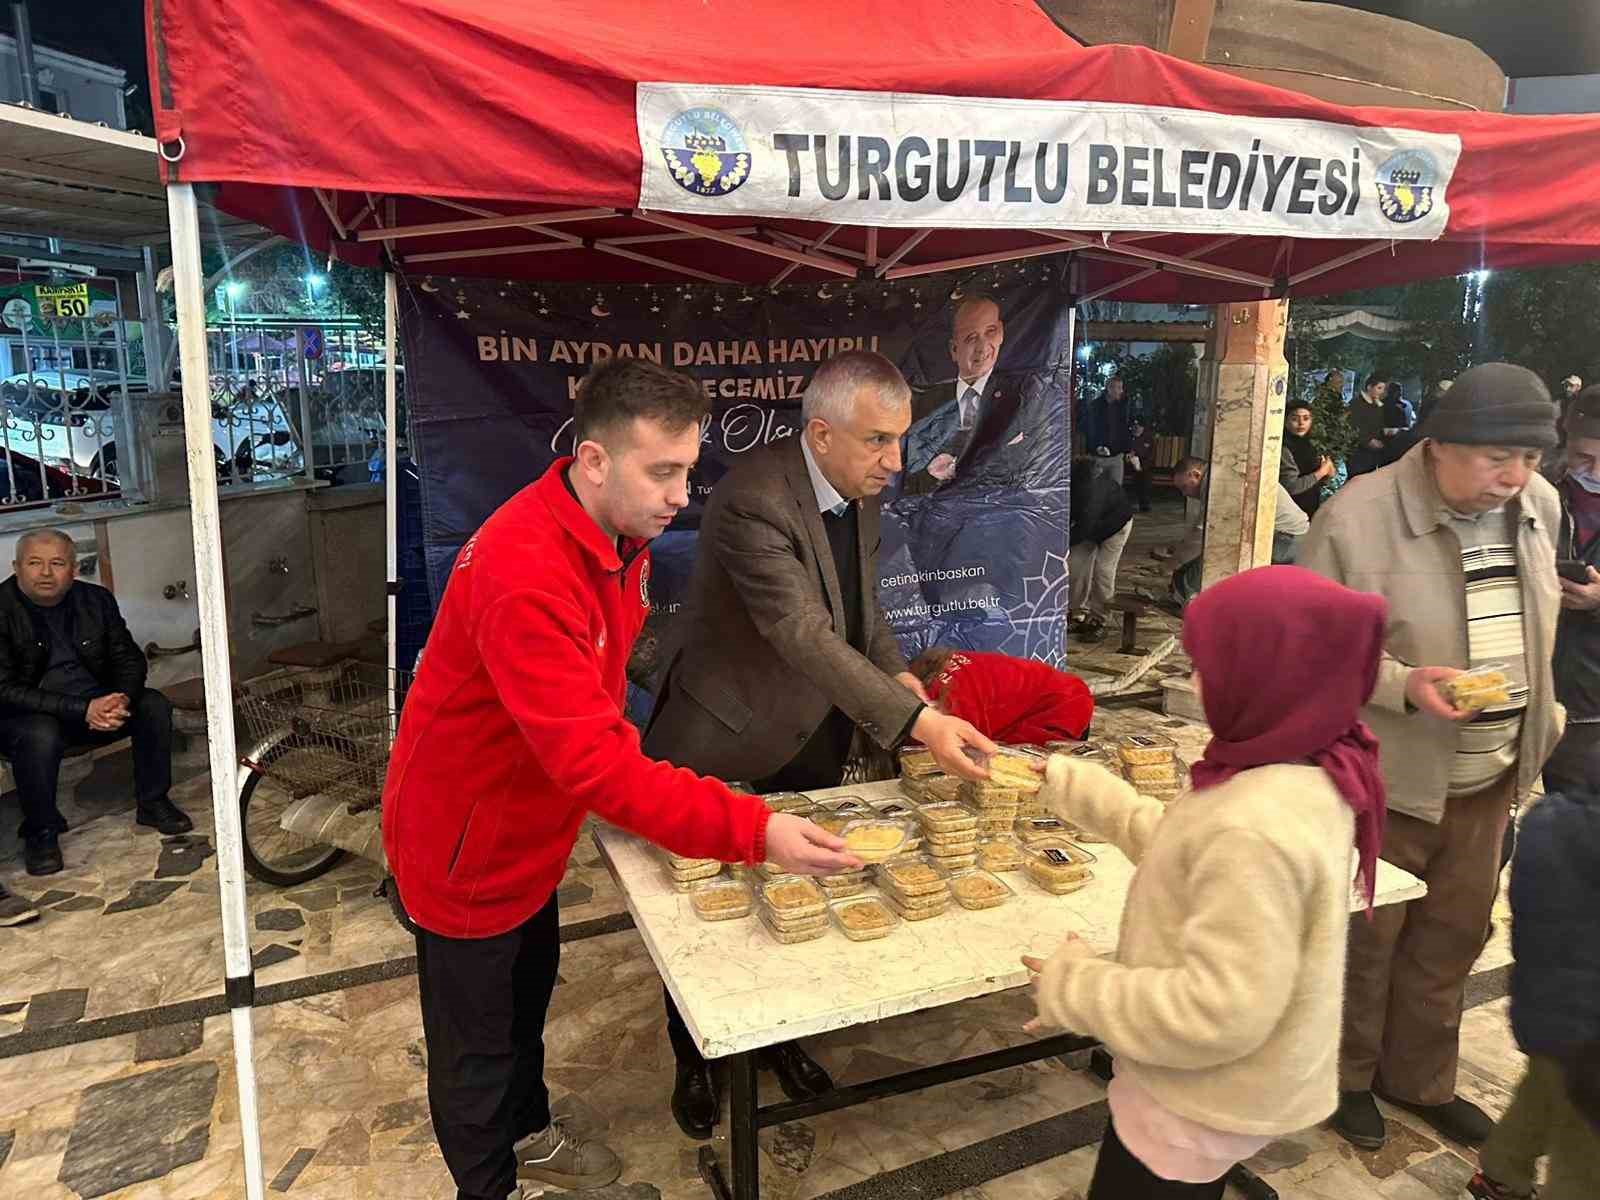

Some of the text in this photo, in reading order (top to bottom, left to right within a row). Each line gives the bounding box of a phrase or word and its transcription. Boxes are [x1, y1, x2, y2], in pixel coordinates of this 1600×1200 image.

[773, 133, 1069, 204] TURGUTLU
[1086, 138, 1361, 216] BELEDİYESİ
[61, 299, 86, 317] 50
[477, 329, 538, 361] BİN
[550, 339, 662, 365] AYDAN
[673, 340, 763, 366] DAHA
[702, 369, 804, 400] ECEMİZ
[880, 565, 986, 588] cetinakinbaskan
[884, 595, 1001, 620] www.turgutlu.bel.tr
